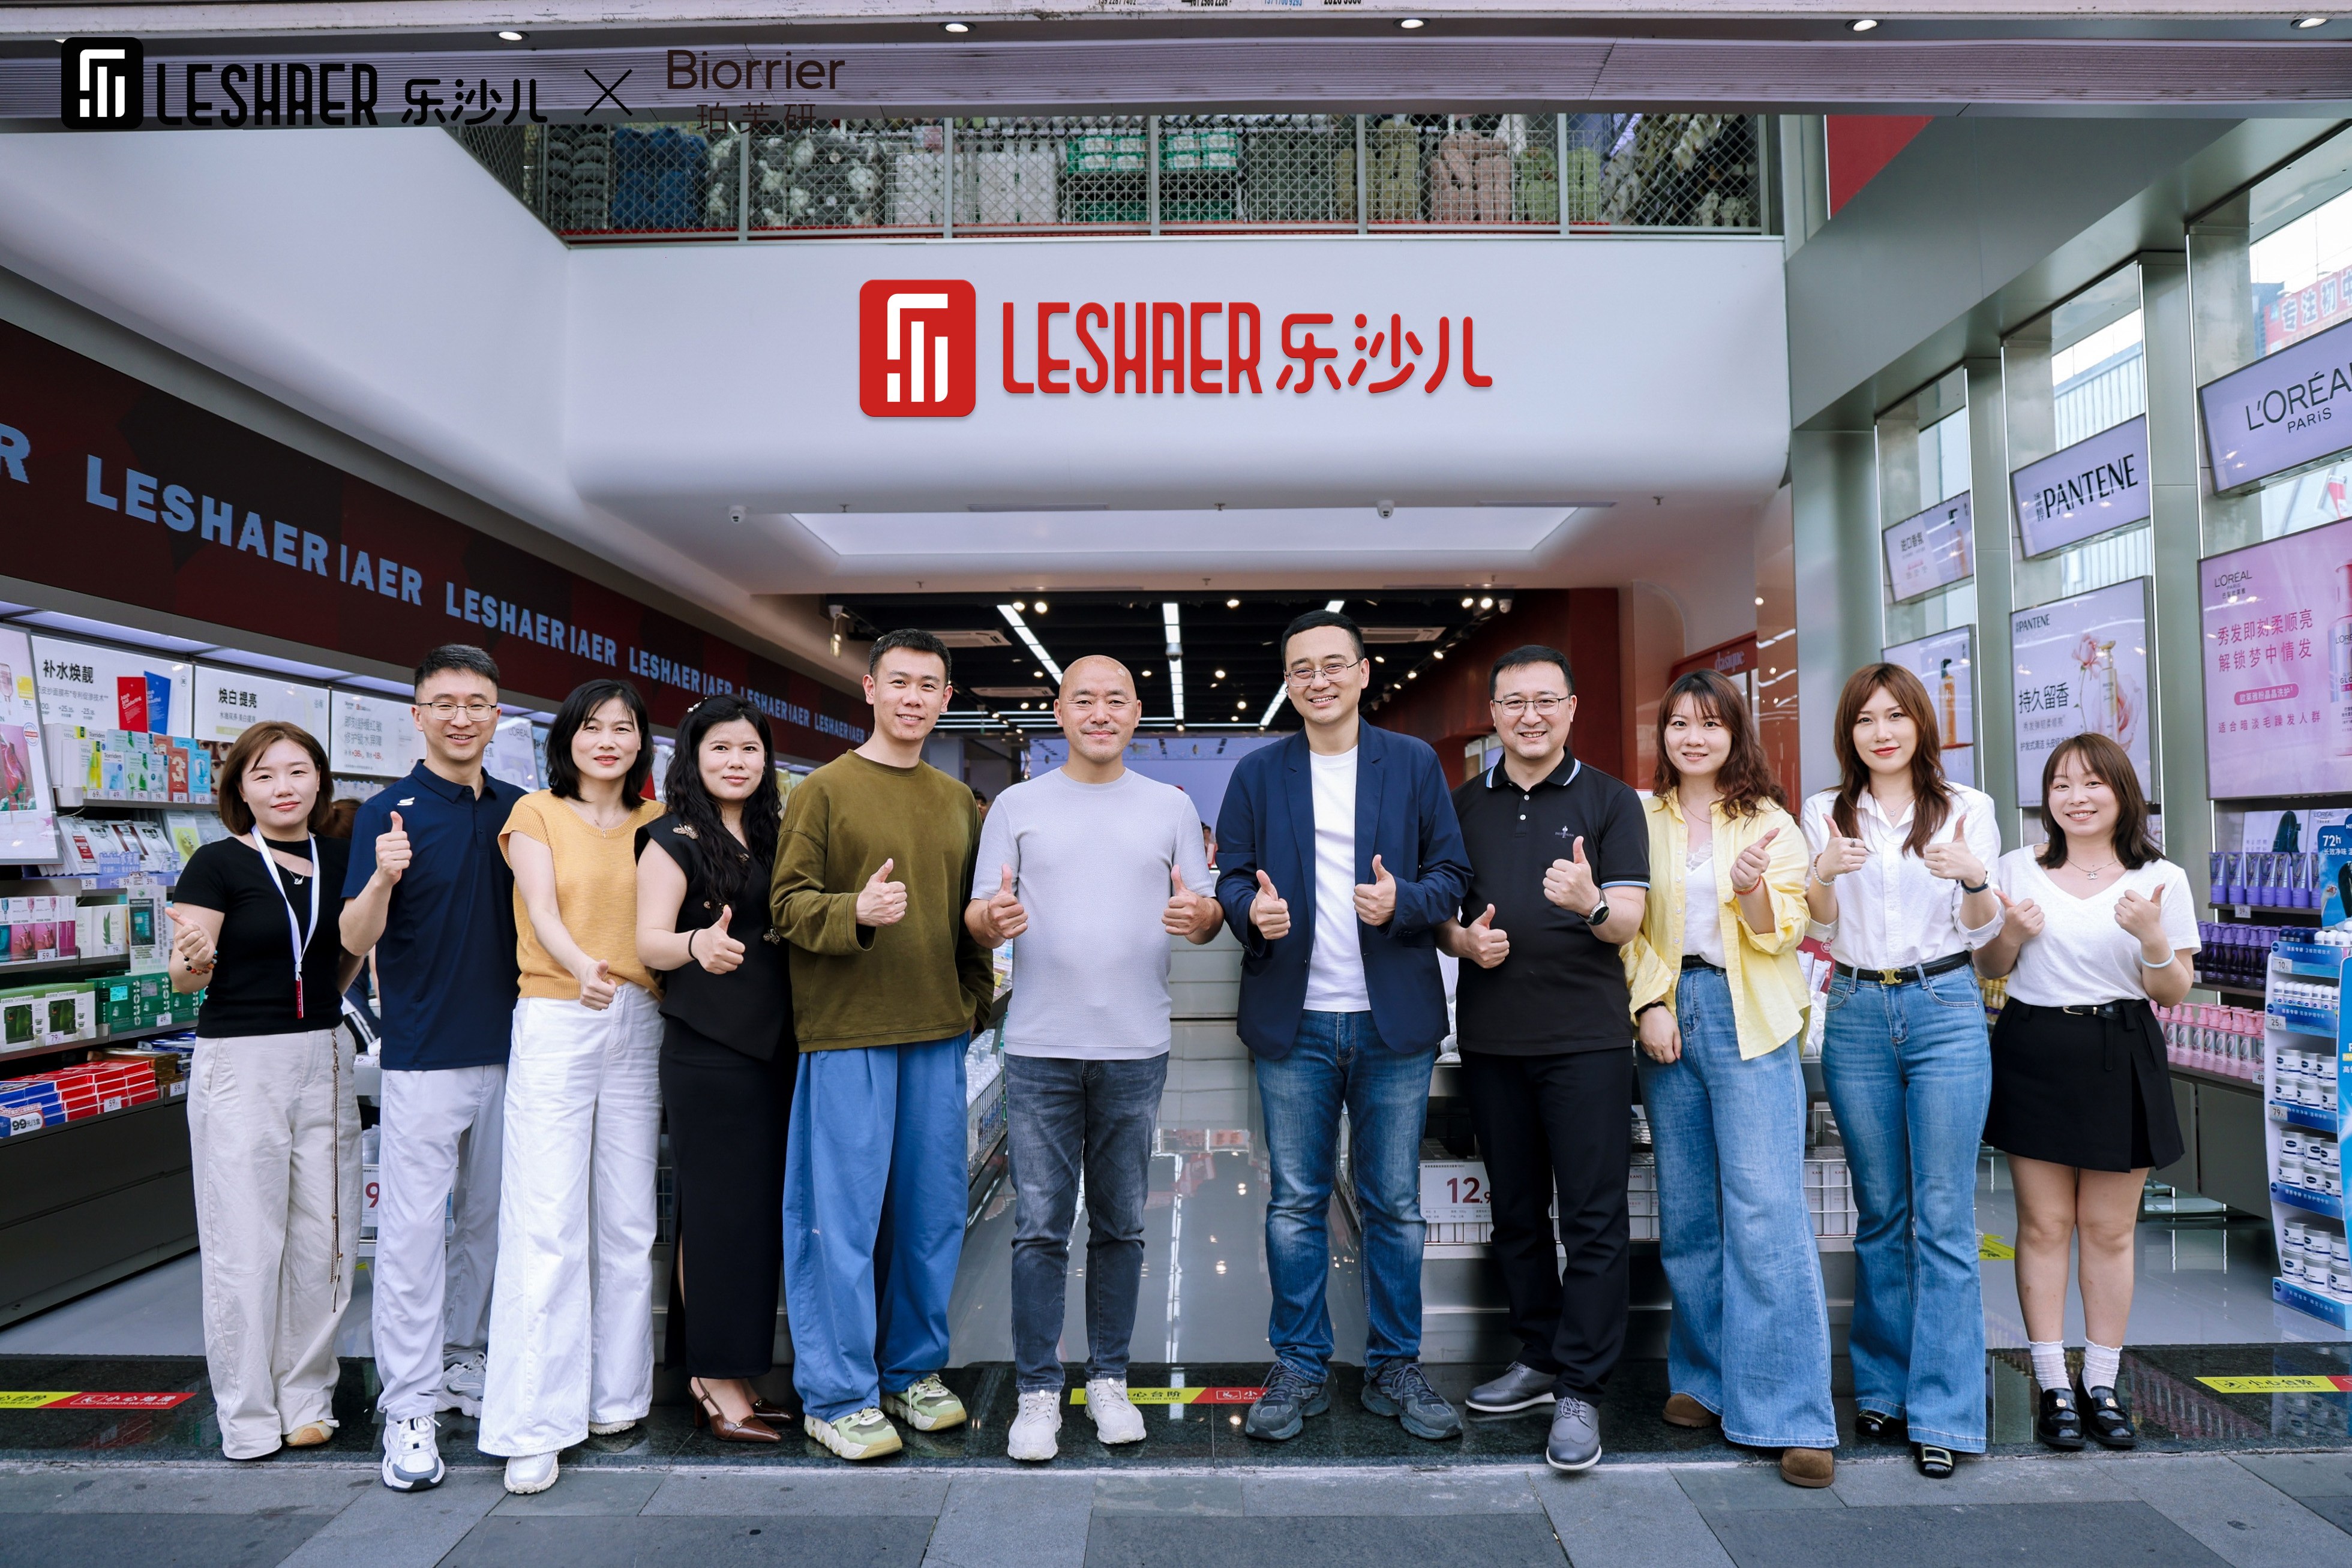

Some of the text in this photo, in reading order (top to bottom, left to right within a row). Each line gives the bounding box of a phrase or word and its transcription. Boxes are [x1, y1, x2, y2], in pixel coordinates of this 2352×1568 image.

[1003, 302, 1493, 394] LESHAER 乐沙儿
[2246, 362, 2352, 431] L'ORÉA
[2043, 453, 2138, 518] PANTENE
[86, 454, 328, 577] LESHAER
[446, 581, 565, 650] LESHAER
[2218, 608, 2313, 646] 秀发即刻柔顺亮
[43, 659, 94, 684] 补水焕靓
[629, 646, 700, 693] LESHAER
[2219, 638, 2312, 672] 解锁梦中情发
[239, 691, 257, 708] 提亮
[2019, 682, 2069, 713] 持久留香
[2218, 710, 2320, 733] 适合暗淡毛躁发人群
[2323, 835, 2341, 846] 72h
